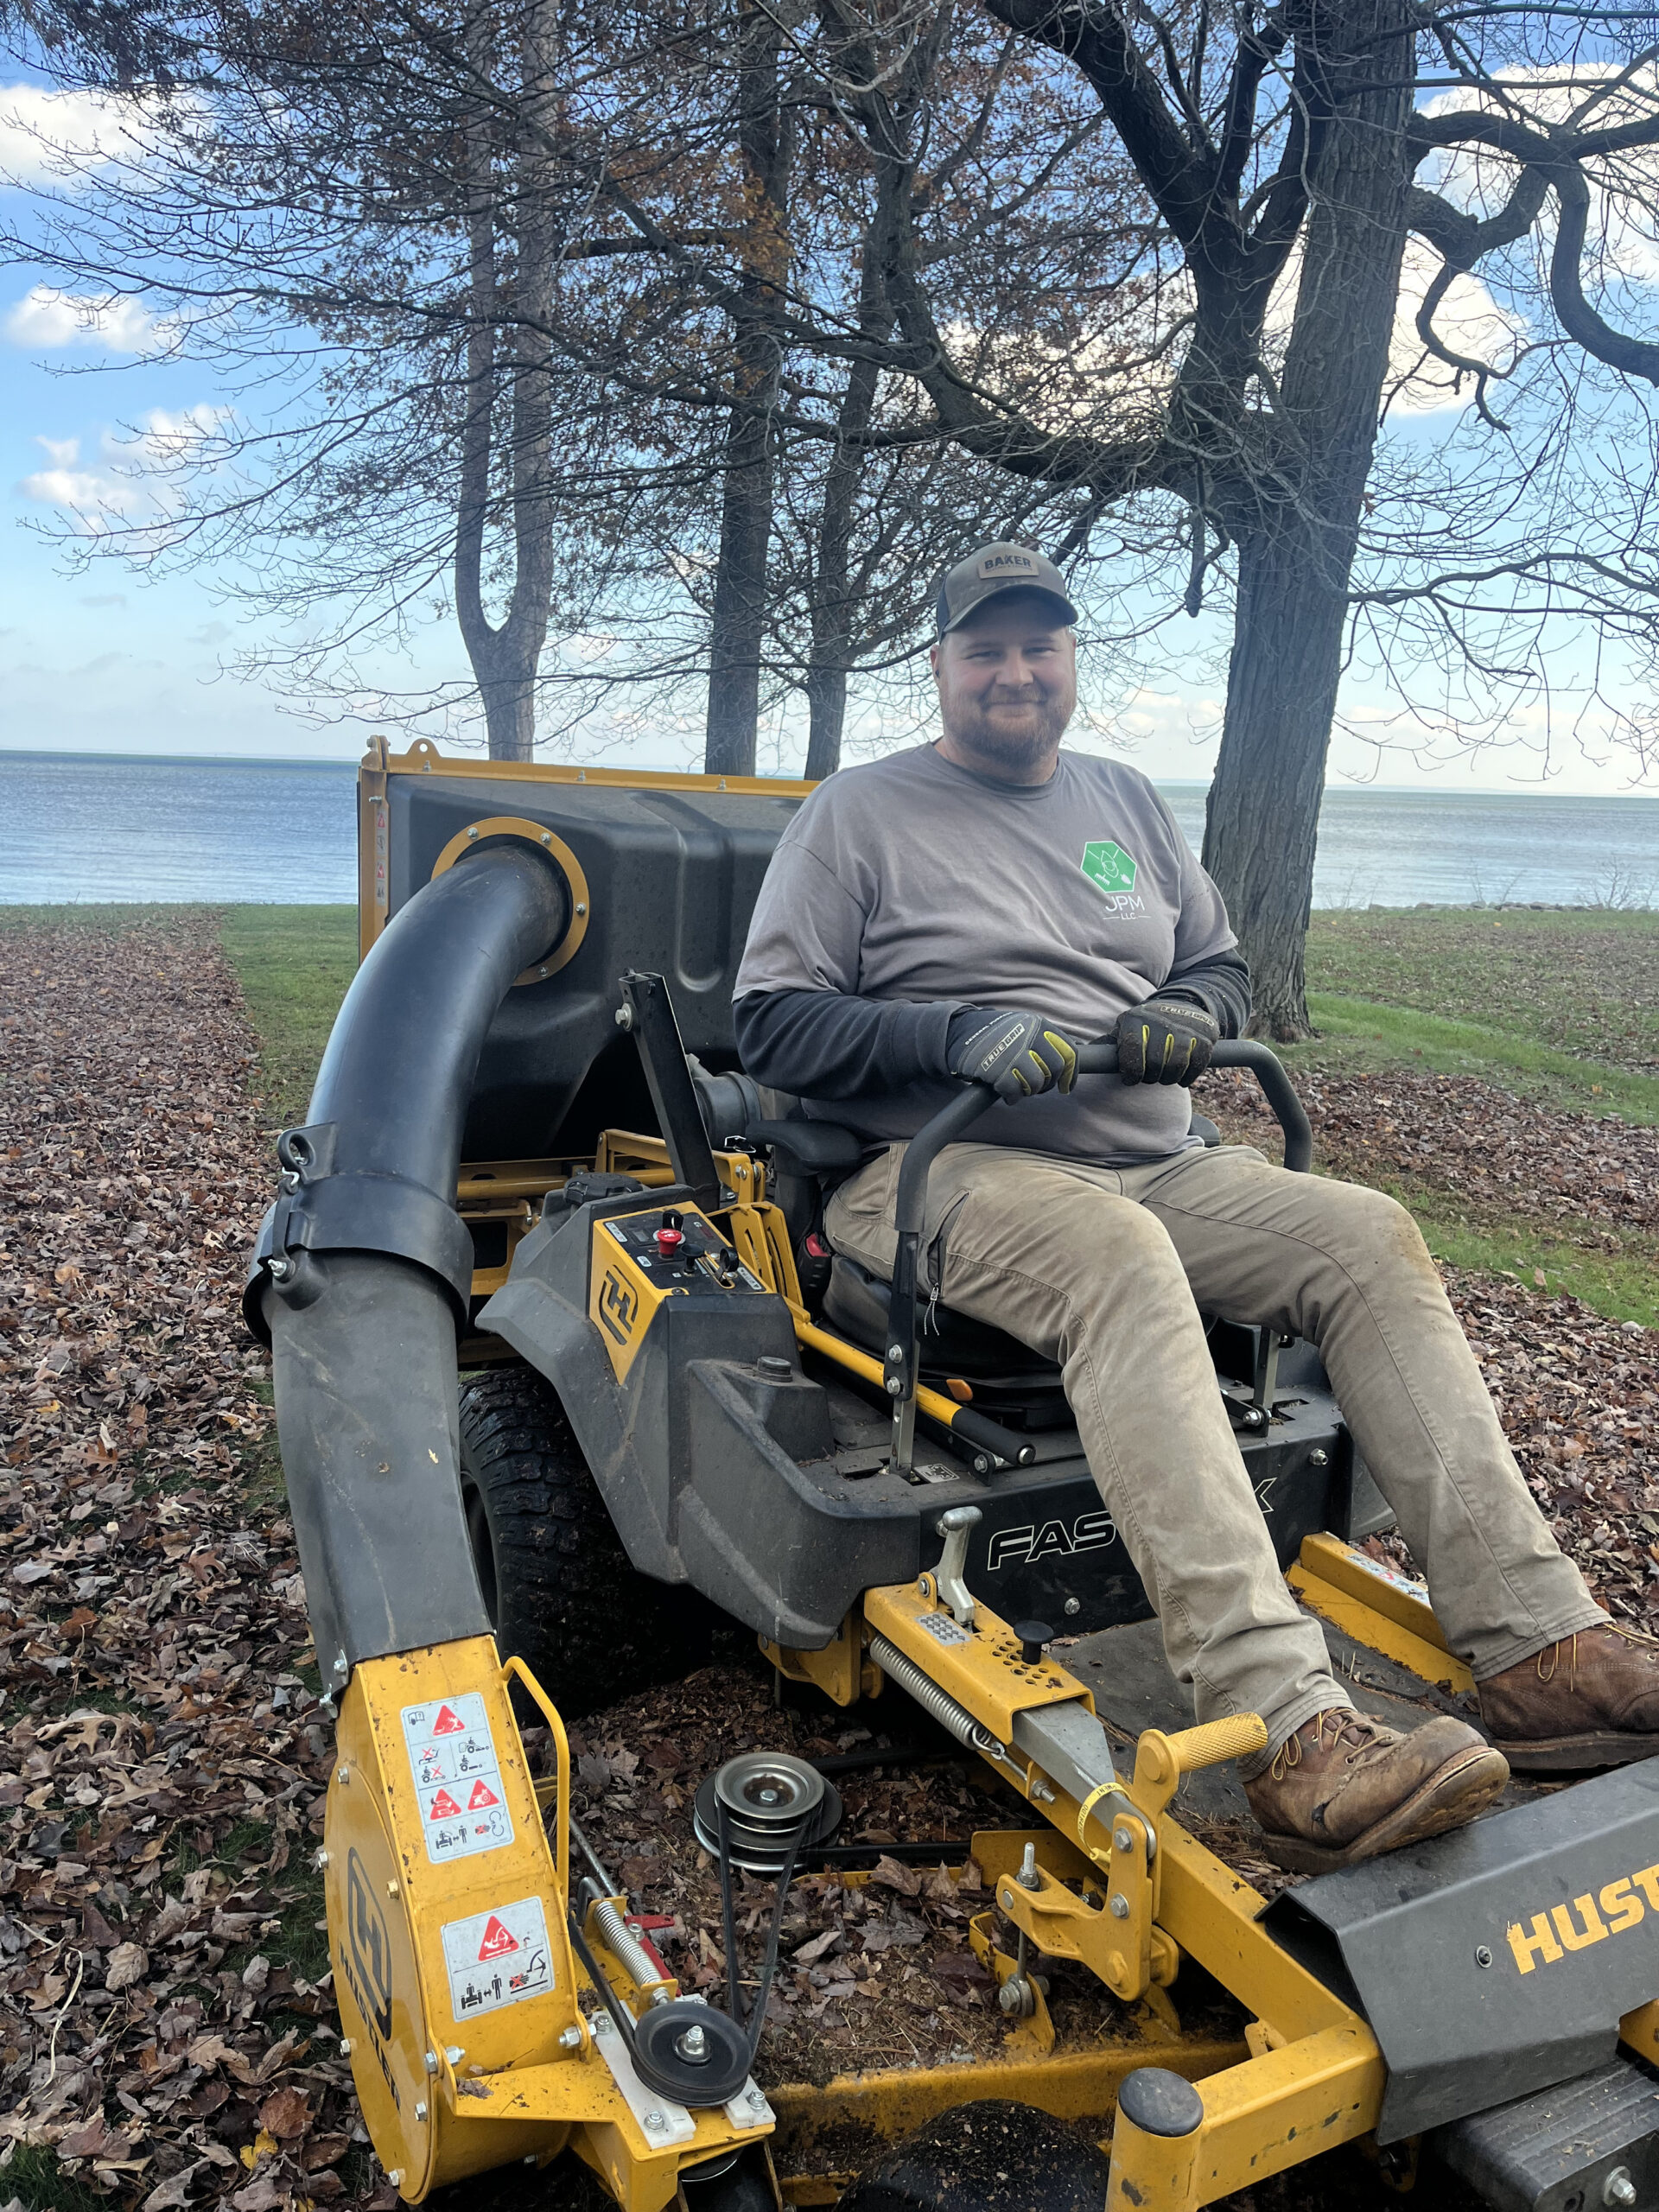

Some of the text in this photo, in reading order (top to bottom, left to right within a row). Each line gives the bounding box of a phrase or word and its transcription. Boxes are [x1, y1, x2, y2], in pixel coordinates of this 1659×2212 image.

[984, 554, 1032, 569] BAKER
[1105, 895, 1145, 912] JPM
[1121, 912, 1136, 920] LLC
[983, 1025, 1023, 1068] TRUE GRIP
